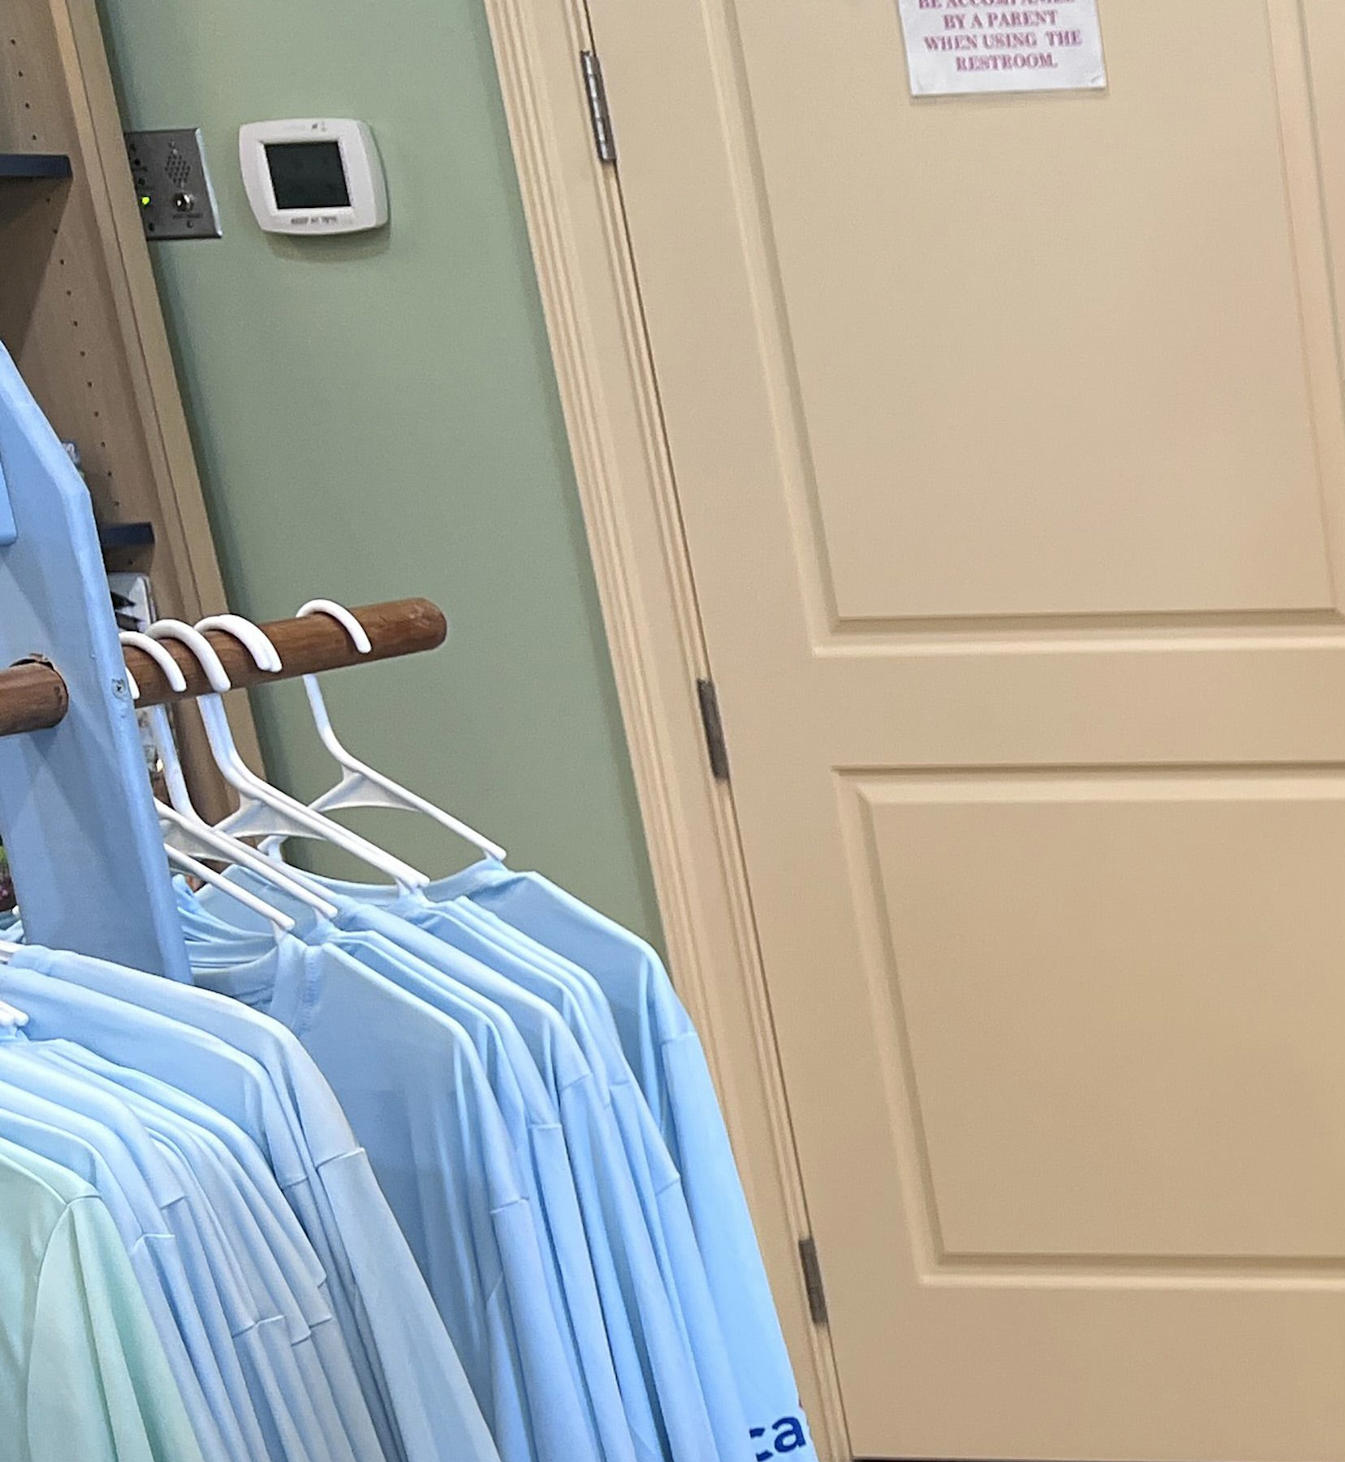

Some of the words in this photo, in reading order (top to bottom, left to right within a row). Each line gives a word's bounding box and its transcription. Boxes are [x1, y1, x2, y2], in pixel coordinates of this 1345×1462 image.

[944, 14, 966, 30] BY
[971, 14, 983, 29] A
[988, 10, 1058, 28] PARENT
[924, 34, 978, 51] WHEN
[983, 32, 1037, 49] USING
[1045, 29, 1082, 47] THE
[956, 53, 1058, 72] RESTROOM.
